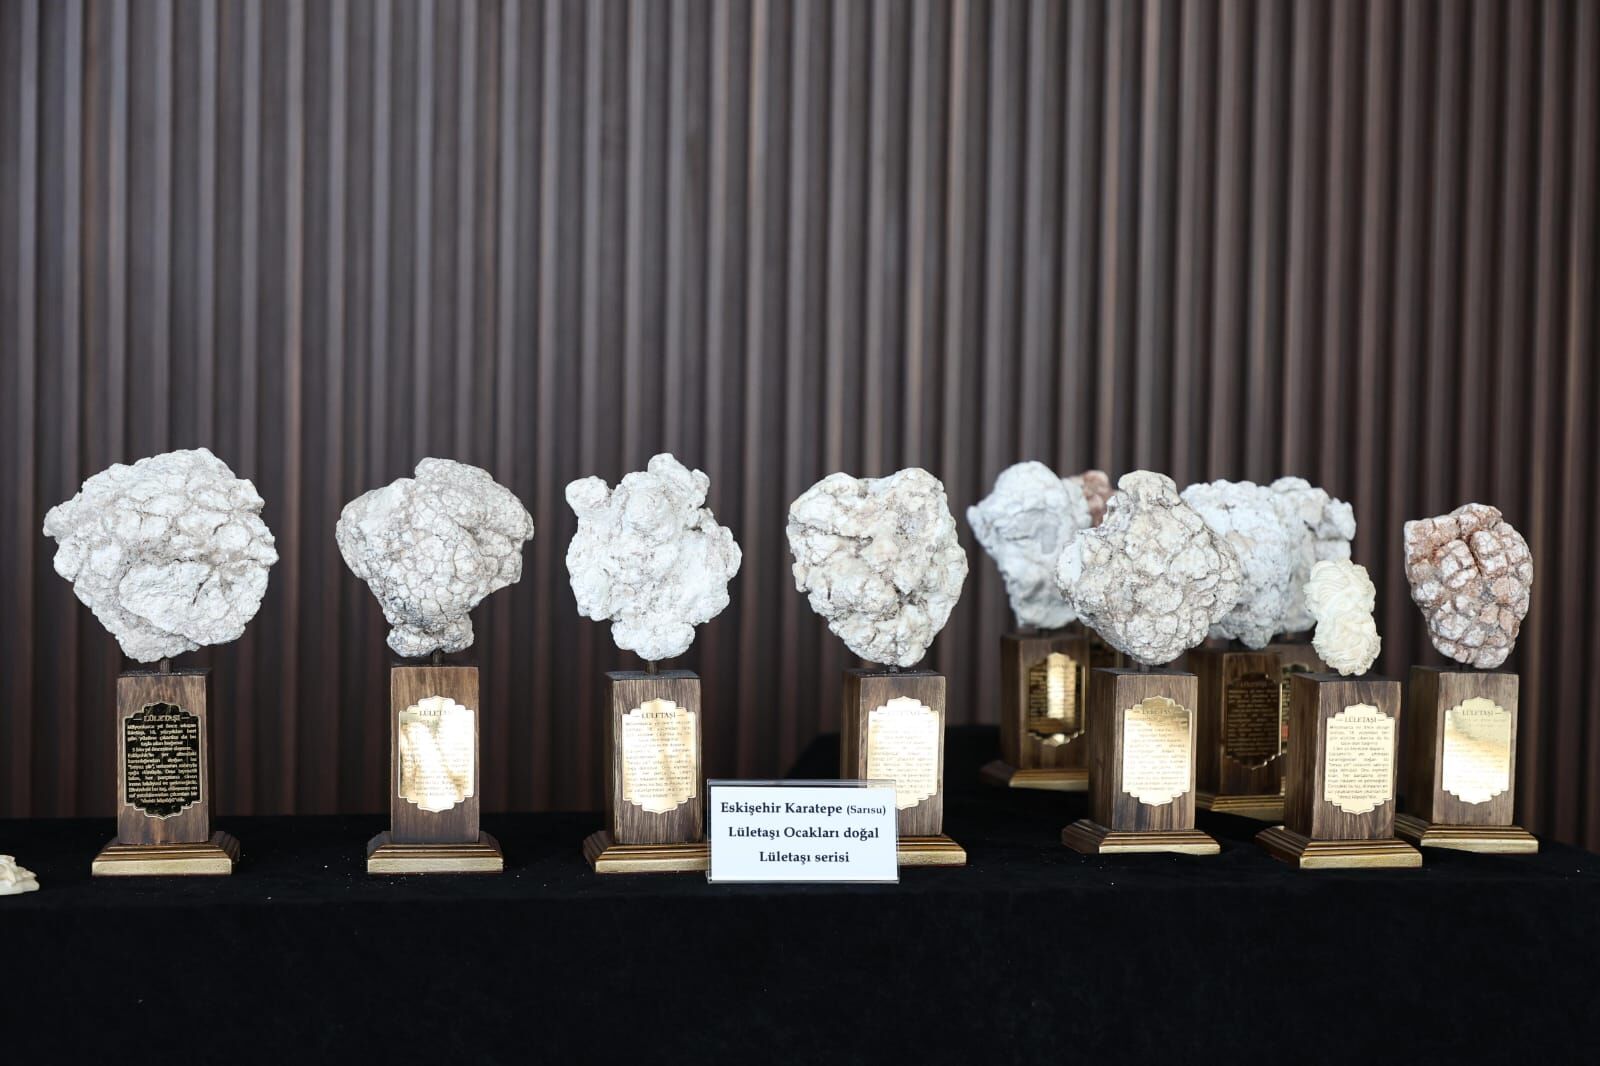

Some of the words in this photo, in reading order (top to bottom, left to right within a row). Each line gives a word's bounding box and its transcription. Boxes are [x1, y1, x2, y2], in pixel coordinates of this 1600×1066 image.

[720, 802, 782, 816] Eskişehir
[785, 802, 842, 816] Karatepe
[846, 804, 886, 816] (Sarısu)
[728, 826, 780, 840] Lületaşı
[784, 826, 840, 838] Ocakları
[844, 827, 879, 841] doğal
[759, 851, 810, 864] Lületaşı
[814, 852, 850, 862] serisi
